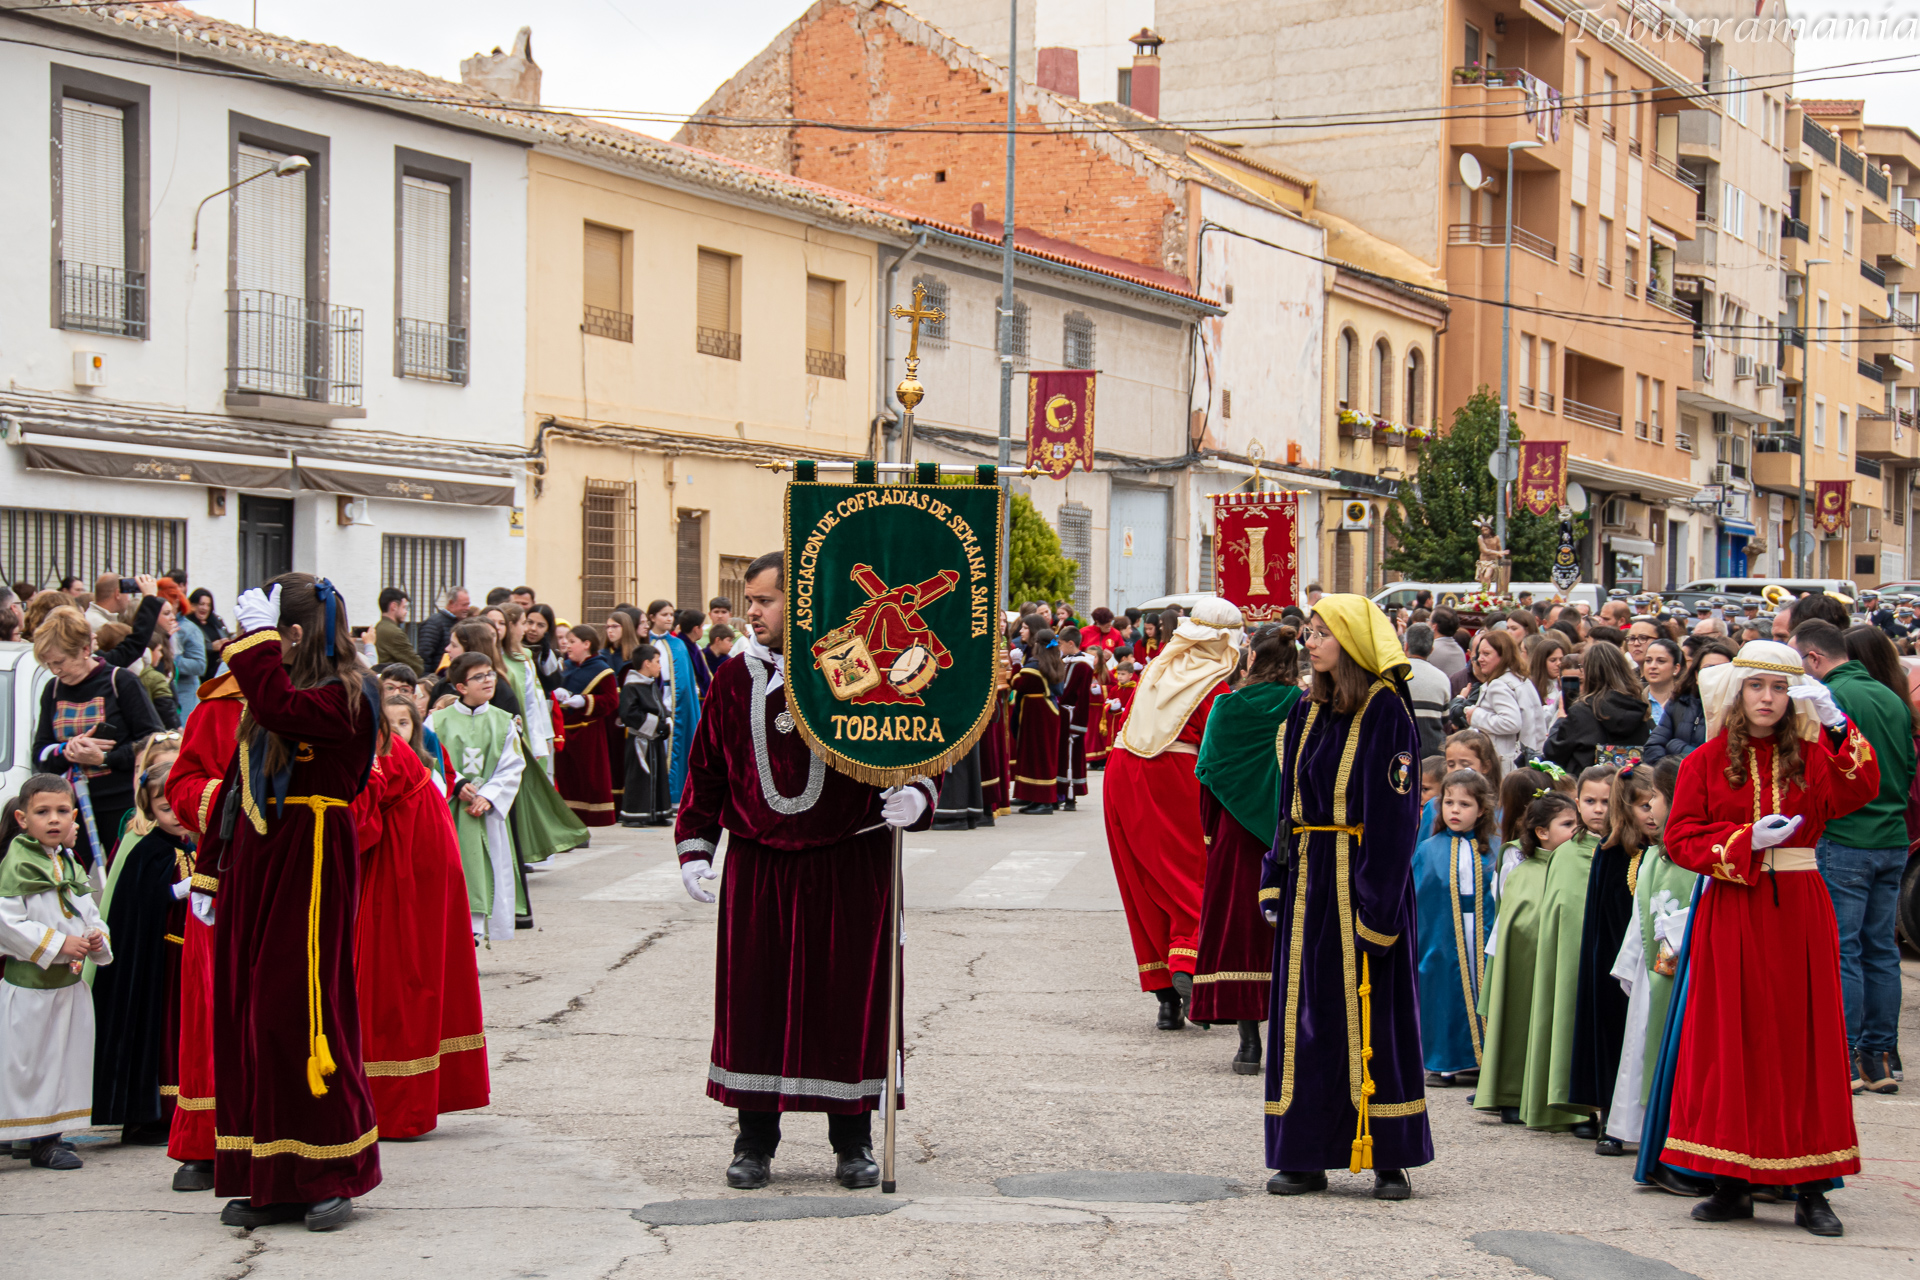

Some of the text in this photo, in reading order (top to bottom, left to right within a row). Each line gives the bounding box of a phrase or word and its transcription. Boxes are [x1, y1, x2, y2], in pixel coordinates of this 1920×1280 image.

[796, 489, 988, 639] ASOCIACION DE COFRADIAS DE SEMANA SANTA
[830, 714, 945, 743] TOBARRA
